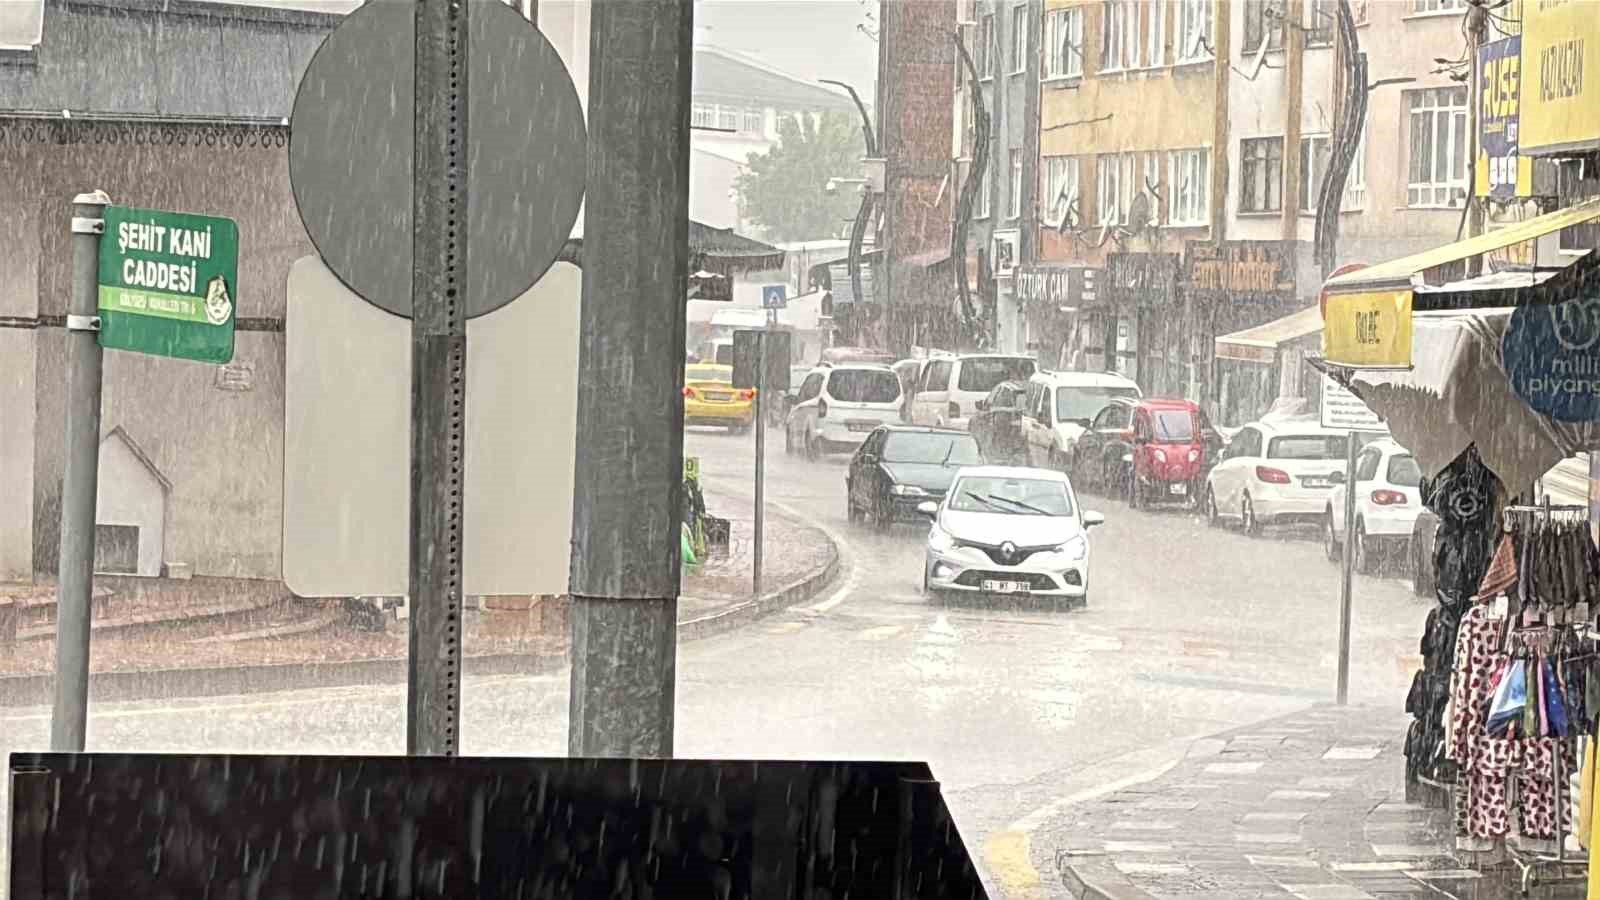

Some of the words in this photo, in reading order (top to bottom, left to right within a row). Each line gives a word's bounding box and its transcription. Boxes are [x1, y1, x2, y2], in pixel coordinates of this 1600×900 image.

[119, 219, 165, 254] ŞEHİT
[169, 225, 211, 259] KANİ
[123, 259, 197, 293] CADDESİ
[1016, 267, 1047, 301] ÖZTÜRK
